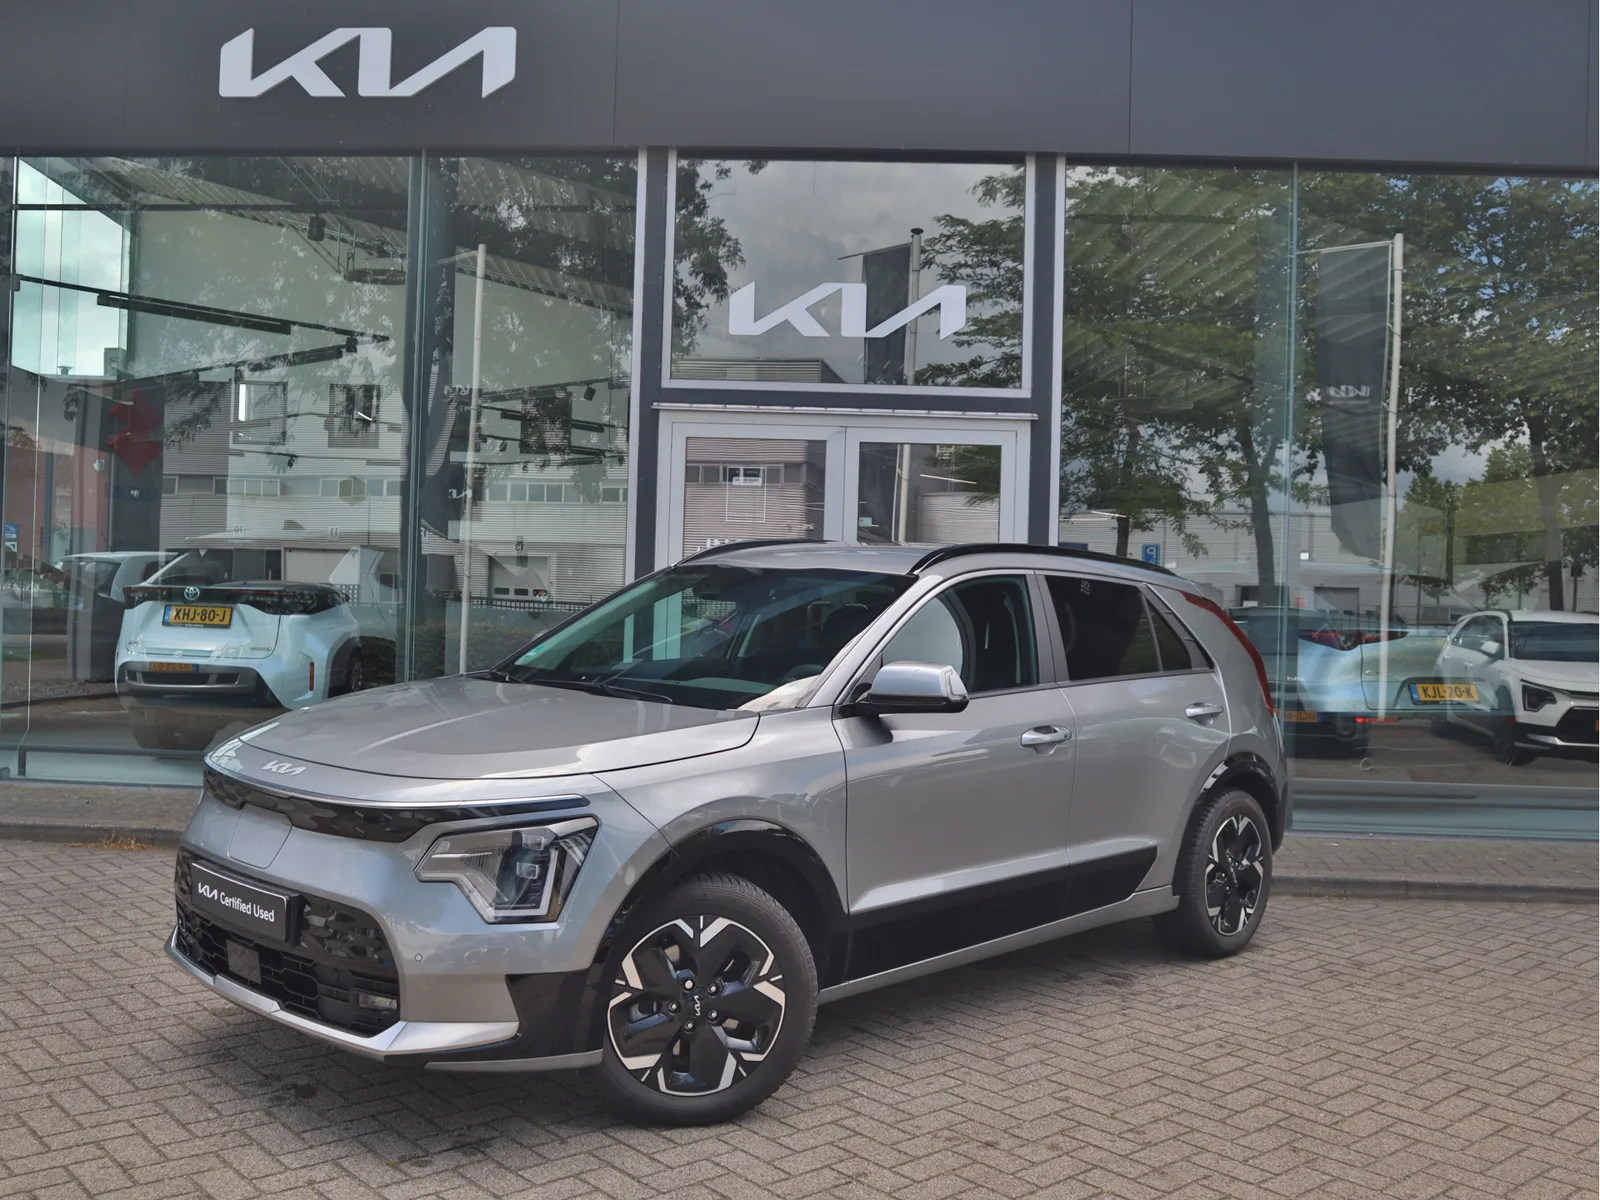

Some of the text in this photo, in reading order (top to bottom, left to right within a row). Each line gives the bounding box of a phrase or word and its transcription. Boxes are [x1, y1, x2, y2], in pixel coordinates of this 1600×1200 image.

[219, 27, 517, 98] KIA
[729, 281, 967, 340] KIA
[174, 607, 226, 623] XHJ-80-J
[1422, 685, 1474, 699] KJL-20-K
[261, 759, 307, 776] KIA
[198, 882, 275, 923] KIA Certified Used
